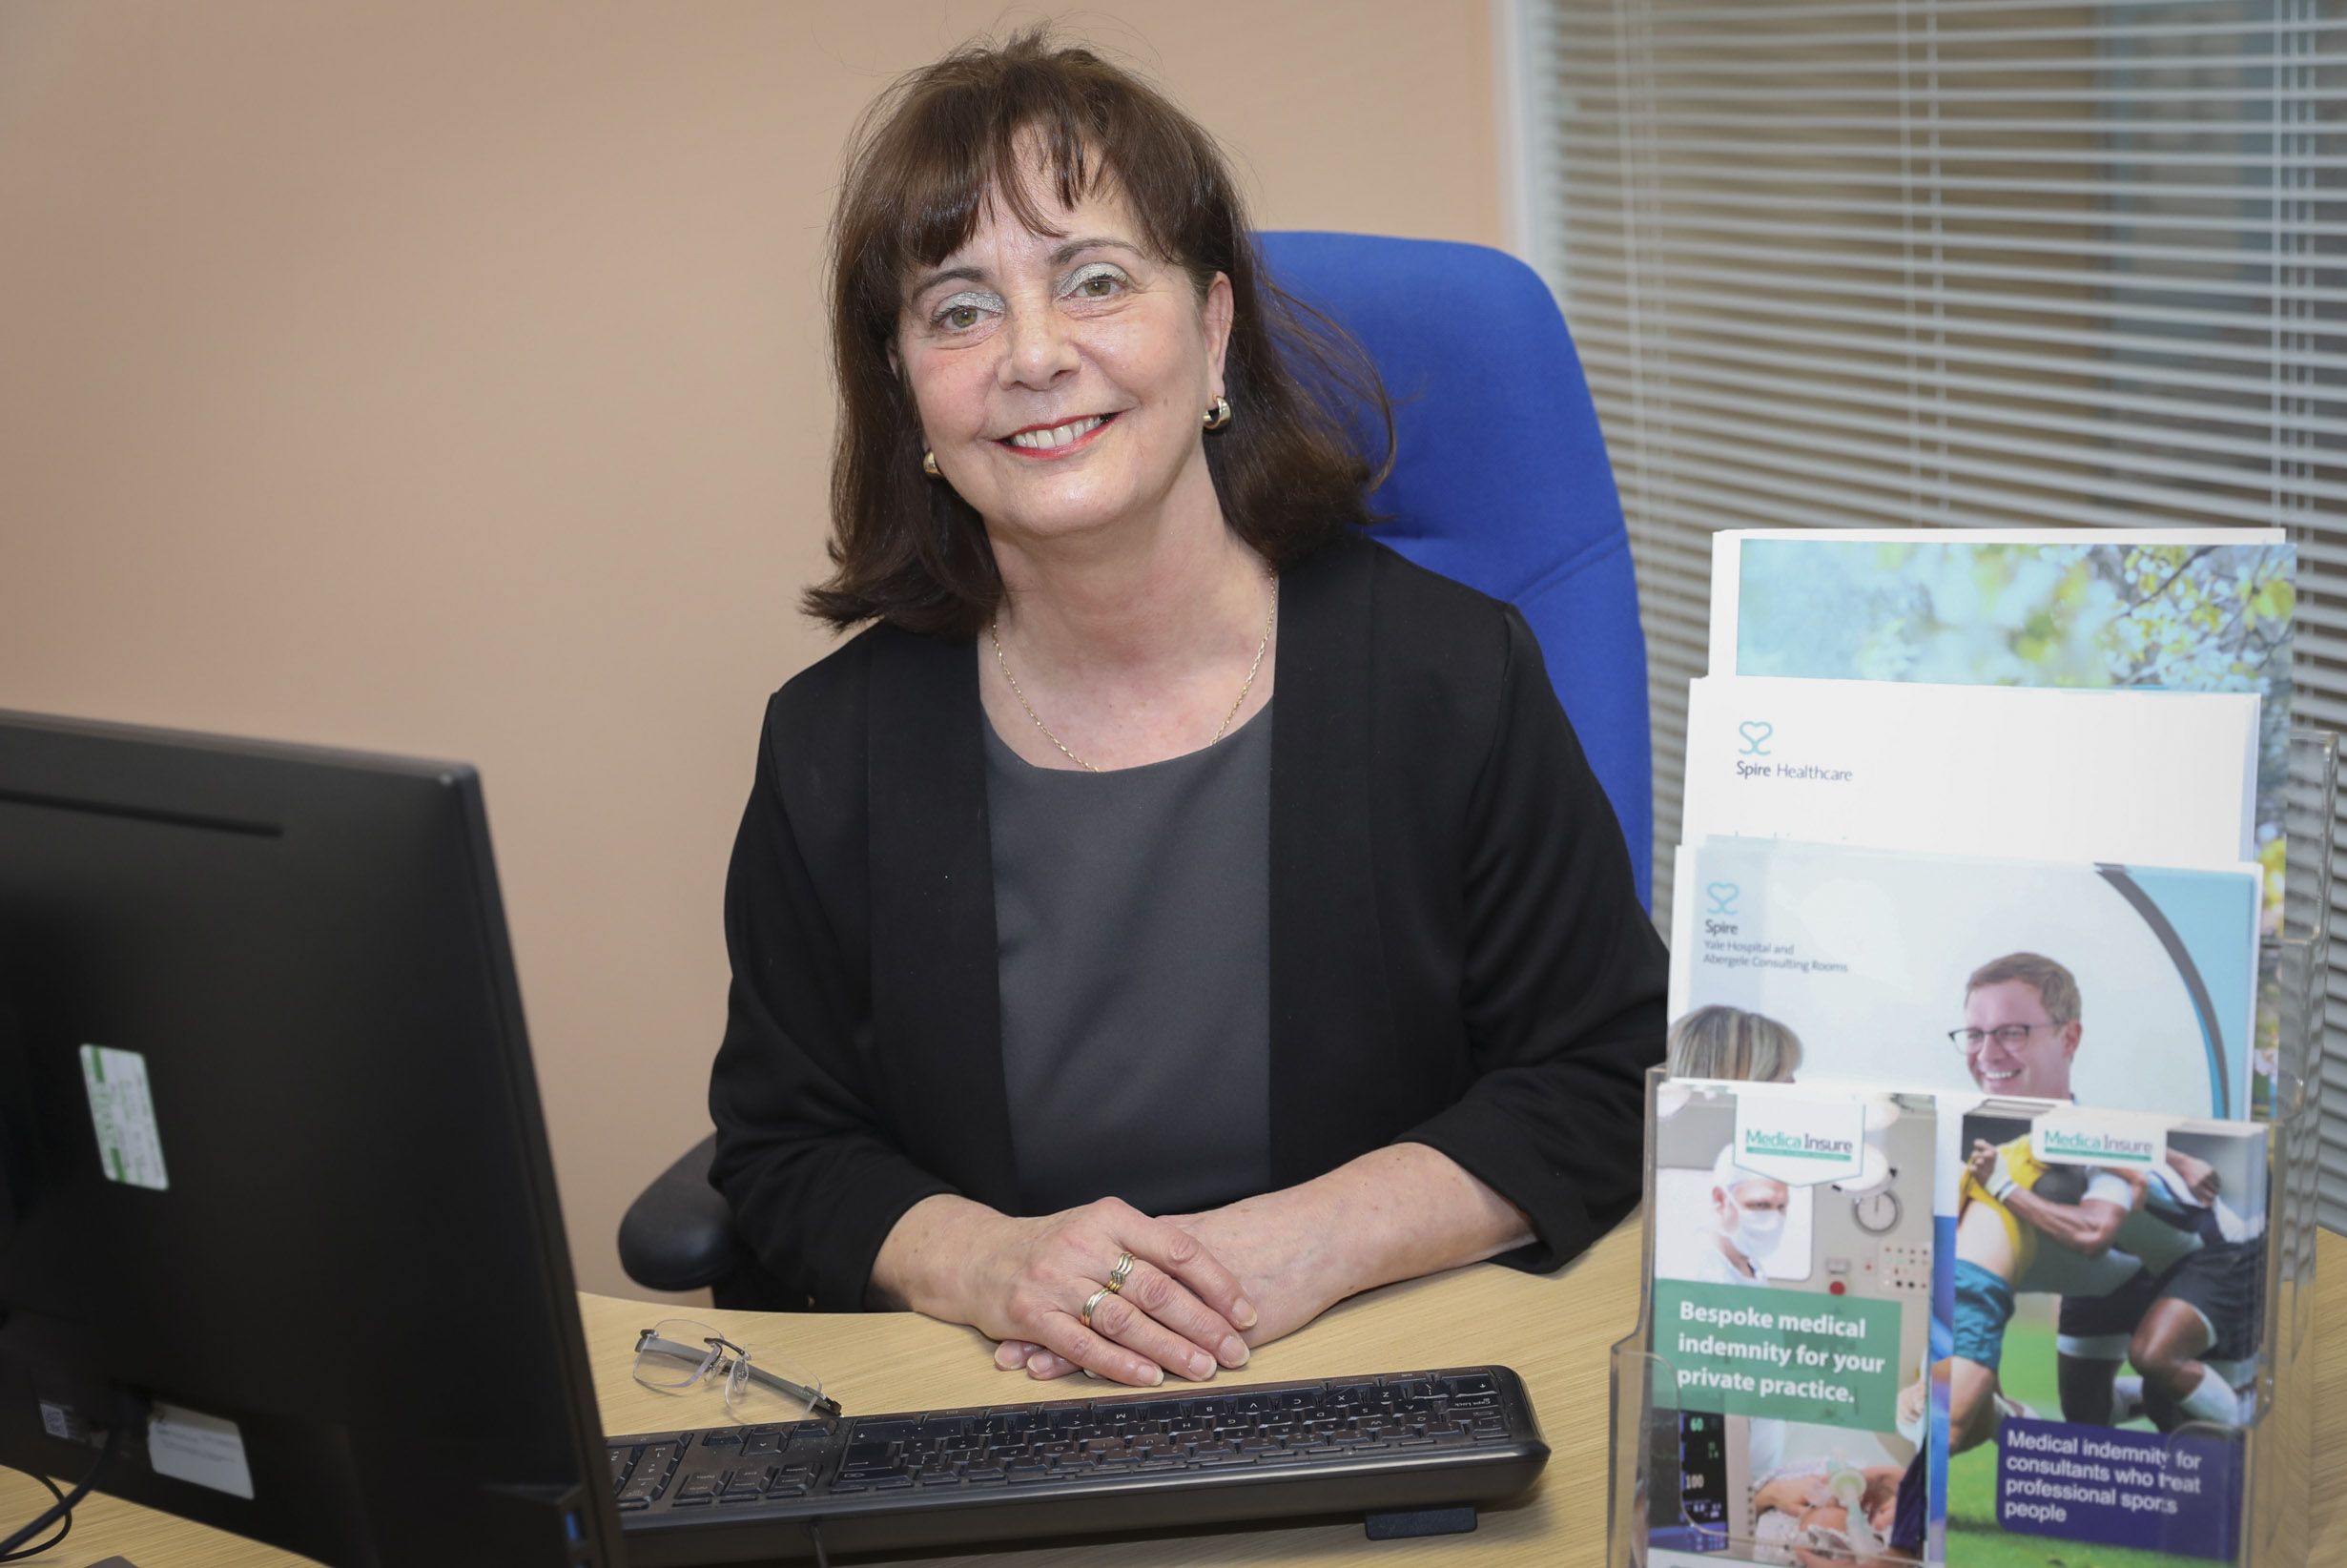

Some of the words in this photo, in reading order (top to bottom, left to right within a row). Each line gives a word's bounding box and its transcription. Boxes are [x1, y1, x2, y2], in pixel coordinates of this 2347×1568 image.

[1737, 760, 1771, 779] Spire
[1777, 763, 1853, 781] Healthcare
[1705, 918, 1739, 937] Spire
[1704, 939, 1725, 951] Yale
[1727, 940, 1772, 955] Hospital
[1774, 944, 1795, 955] and
[1703, 954, 1749, 968] Abergele
[1752, 956, 1810, 973] Consulting
[1812, 959, 1848, 972] Rooms
[1679, 1301, 1773, 1329] Bespoke
[1778, 1314, 1866, 1338] medical
[1678, 1332, 1792, 1367] indemnity
[1796, 1345, 1829, 1367] for
[1833, 1353, 1885, 1373] your
[1677, 1367, 1755, 1391] private
[1760, 1378, 1855, 1403] practice.
[2007, 1430, 2078, 1455] Medical
[2083, 1438, 2170, 1468] indemnity
[2175, 1451, 2202, 1469] for
[2006, 1455, 2110, 1482] consultants
[2114, 1468, 2154, 1487] who
[2005, 1478, 2116, 1506] professional
[2121, 1492, 2178, 1515] spors
[2005, 1501, 2068, 1523] people
